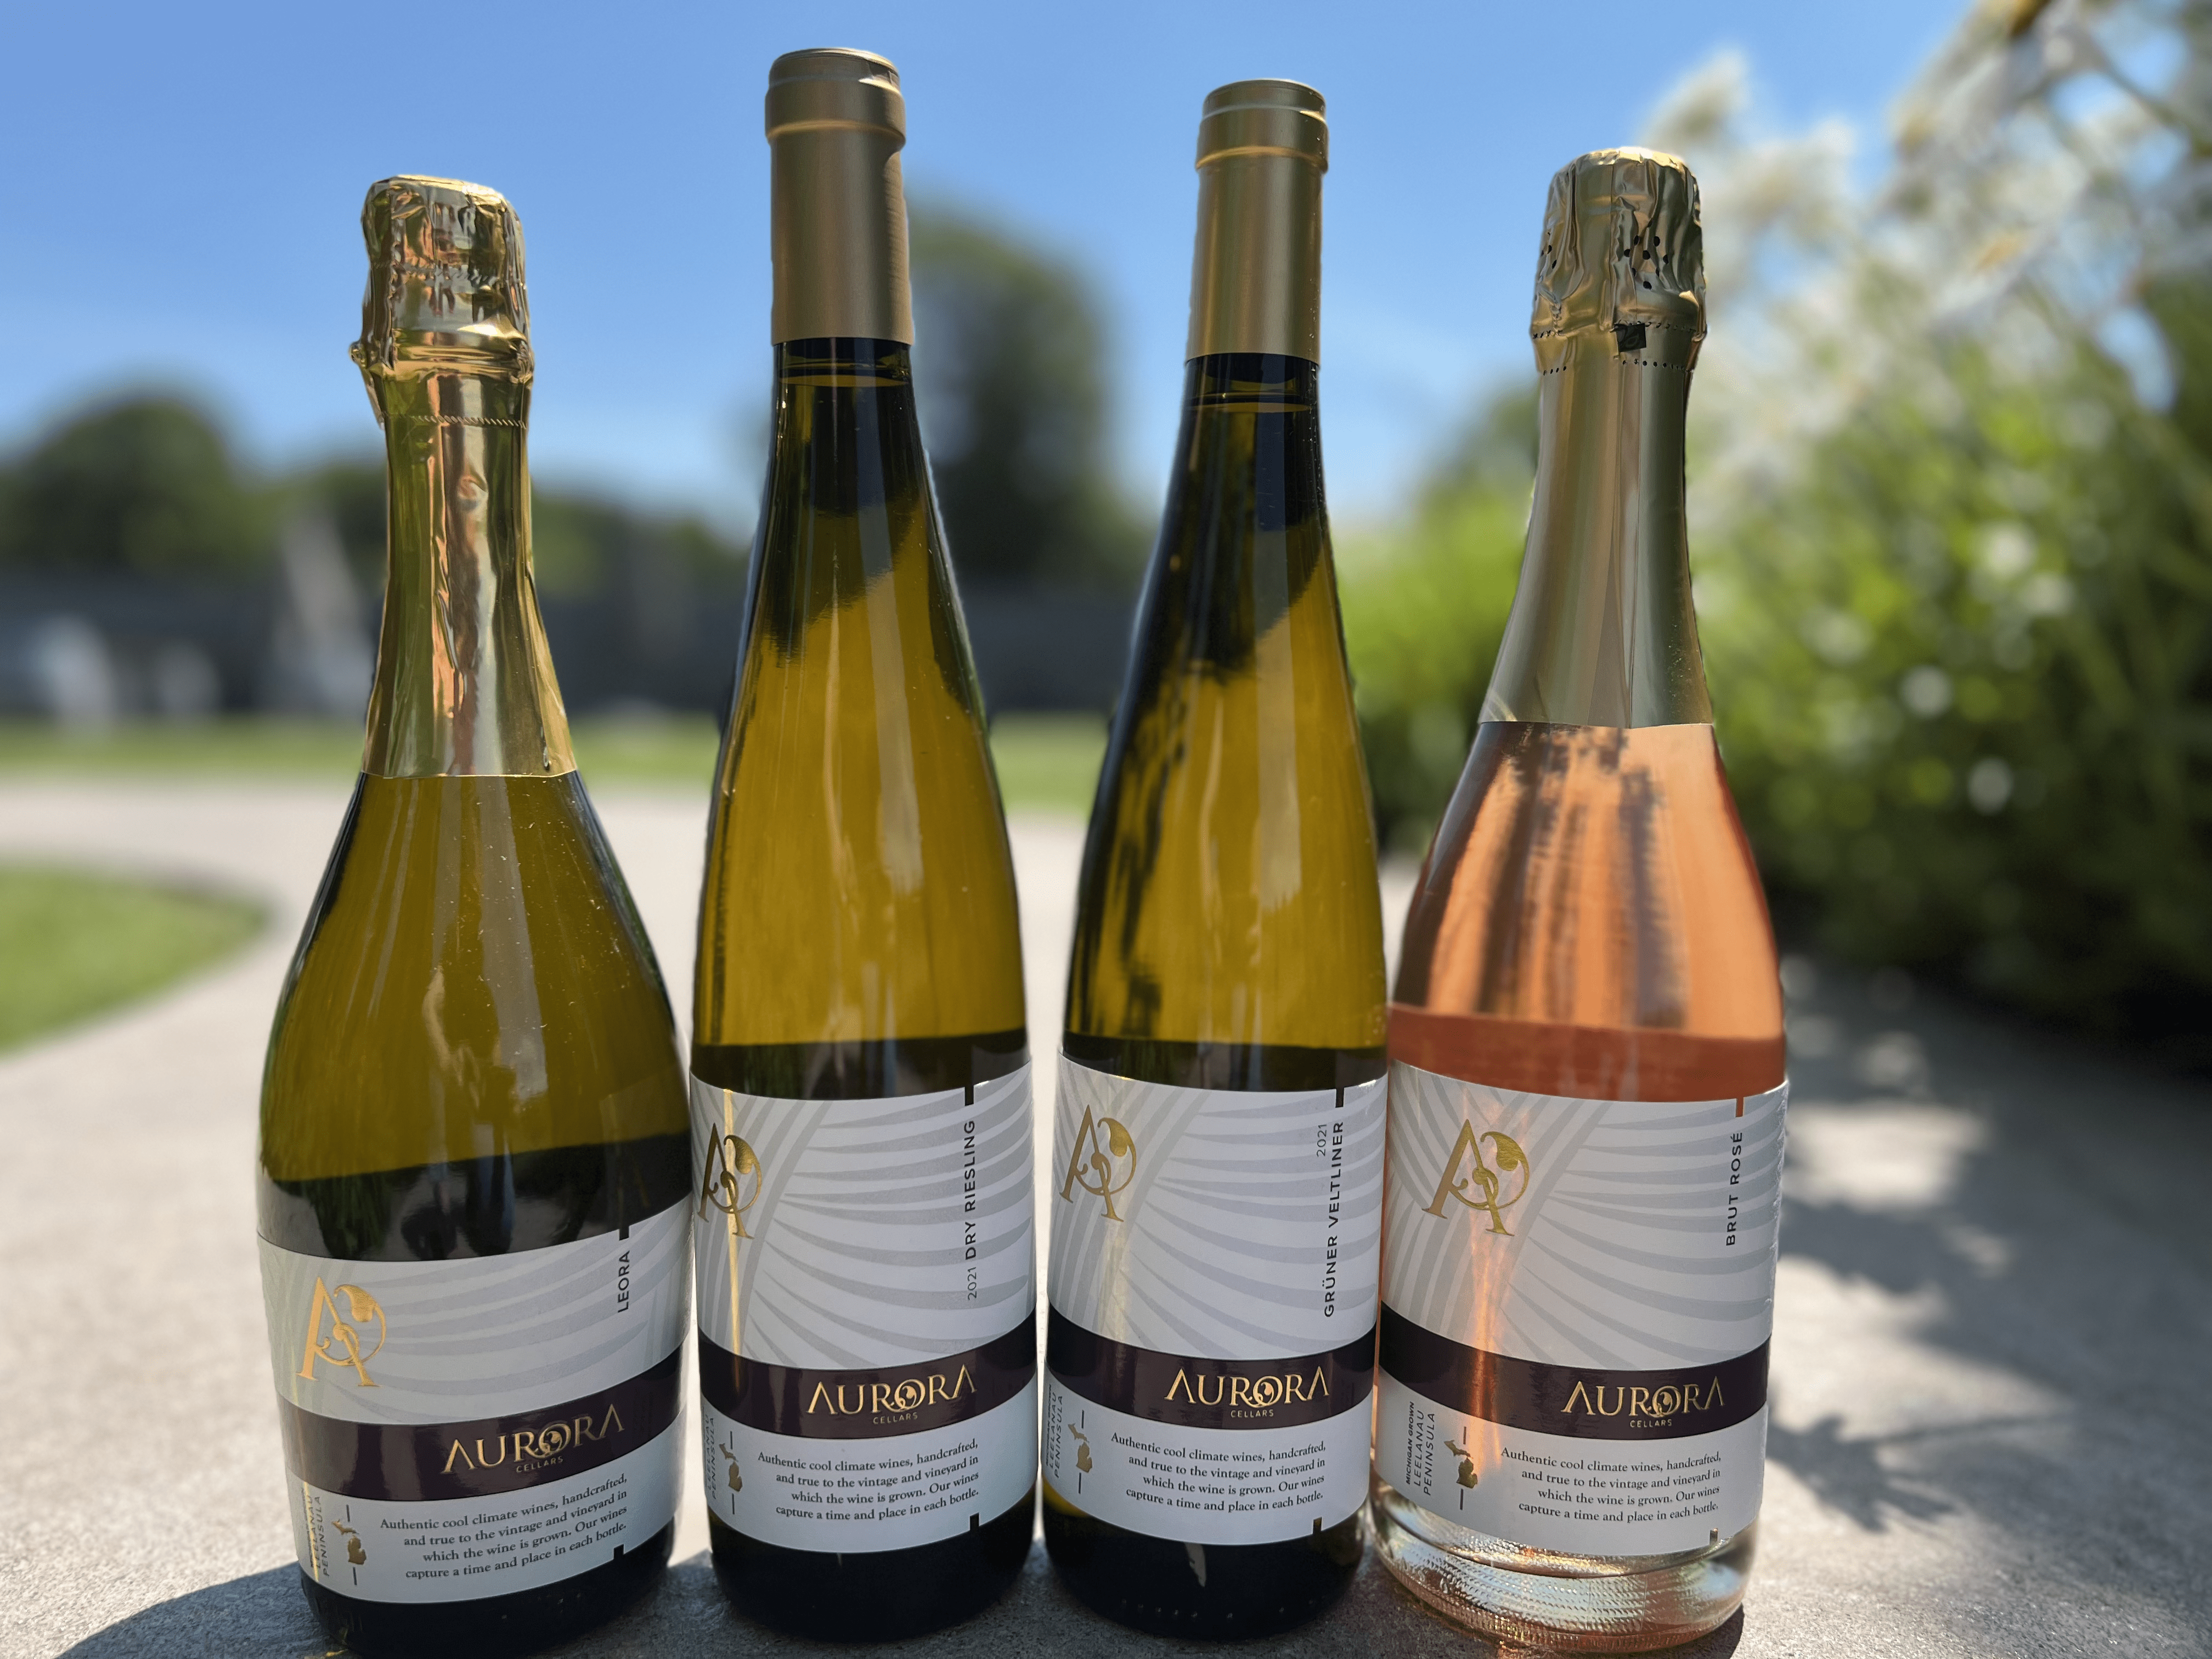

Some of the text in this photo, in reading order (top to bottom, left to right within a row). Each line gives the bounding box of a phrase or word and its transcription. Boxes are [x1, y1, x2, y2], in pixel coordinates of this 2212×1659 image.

[1317, 1124, 1327, 1157] 2021
[1726, 1132, 1742, 1246] BRUT ROSÉ
[964, 1121, 977, 1300] 2021 DRY RIESLING
[1322, 1122, 1343, 1317] GRÜNER VELTLINER
[617, 1250, 630, 1313] LEORA
[806, 1364, 977, 1415] AURORA
[1164, 1366, 1329, 1408] AURORA
[1561, 1376, 1725, 1418] AURORA
[873, 1412, 917, 1424] CELLARS
[1231, 1409, 1274, 1418] CELLARS
[1629, 1419, 1672, 1427] CELLARS
[441, 1404, 624, 1474] AURORA
[758, 1438, 978, 1471] Authentic cool climate wines, handcrafted,
[1111, 1432, 1325, 1462] Authentic cool climate wines, handcrafted,
[1414, 1410, 1424, 1486] LEELANAU
[1424, 1414, 1435, 1496] PENINSULA
[516, 1456, 563, 1472] CELLARS
[776, 1455, 978, 1487] and true to the vintage and vineyard in
[1128, 1456, 1325, 1480] and true to the vintage and vineyard in
[1502, 1447, 1721, 1472] Authentic cool climate wines, handcrafted,
[792, 1472, 979, 1503] which the wine is grown. Our wines
[1143, 1475, 1324, 1497] which the wine is grown. Our wines
[1522, 1469, 1720, 1489] and true to the vintage and vineyard in
[381, 1473, 627, 1530] Authentic cool climate wines, handcrafted,
[776, 1505, 813, 1519] capture
[826, 1511, 850, 1520] time
[854, 1510, 874, 1520] and
[878, 1508, 906, 1520] place
[910, 1505, 920, 1514] in
[924, 1499, 946, 1511] each
[950, 1488, 979, 1505] bottle.
[1126, 1487, 1164, 1504] capture
[1176, 1497, 1200, 1509] time
[1204, 1501, 1224, 1510] and
[1228, 1500, 1255, 1513] place
[1259, 1500, 1268, 1510] in
[1272, 1496, 1294, 1509] each
[1297, 1489, 1323, 1505] bottle.
[1519, 1502, 1560, 1517] capture
[1574, 1510, 1599, 1521] time
[1603, 1511, 1623, 1521] and
[1627, 1511, 1654, 1523] place
[1657, 1511, 1667, 1520] in
[1669, 1506, 1690, 1519] each
[1693, 1500, 1718, 1515] bottle.
[1538, 1486, 1719, 1506] which the wine is grown. Our wines
[404, 1490, 627, 1545] and true to the vintage and vineyard in
[423, 1506, 627, 1562] which the wine is grown. Our wines
[315, 1497, 329, 1576] PENINSULA
[405, 1568, 449, 1579] capture
[464, 1565, 491, 1575] time
[495, 1558, 517, 1570] and
[522, 1550, 551, 1566] place
[555, 1545, 566, 1556] in
[569, 1537, 592, 1551] each
[596, 1522, 626, 1541] bottle.
